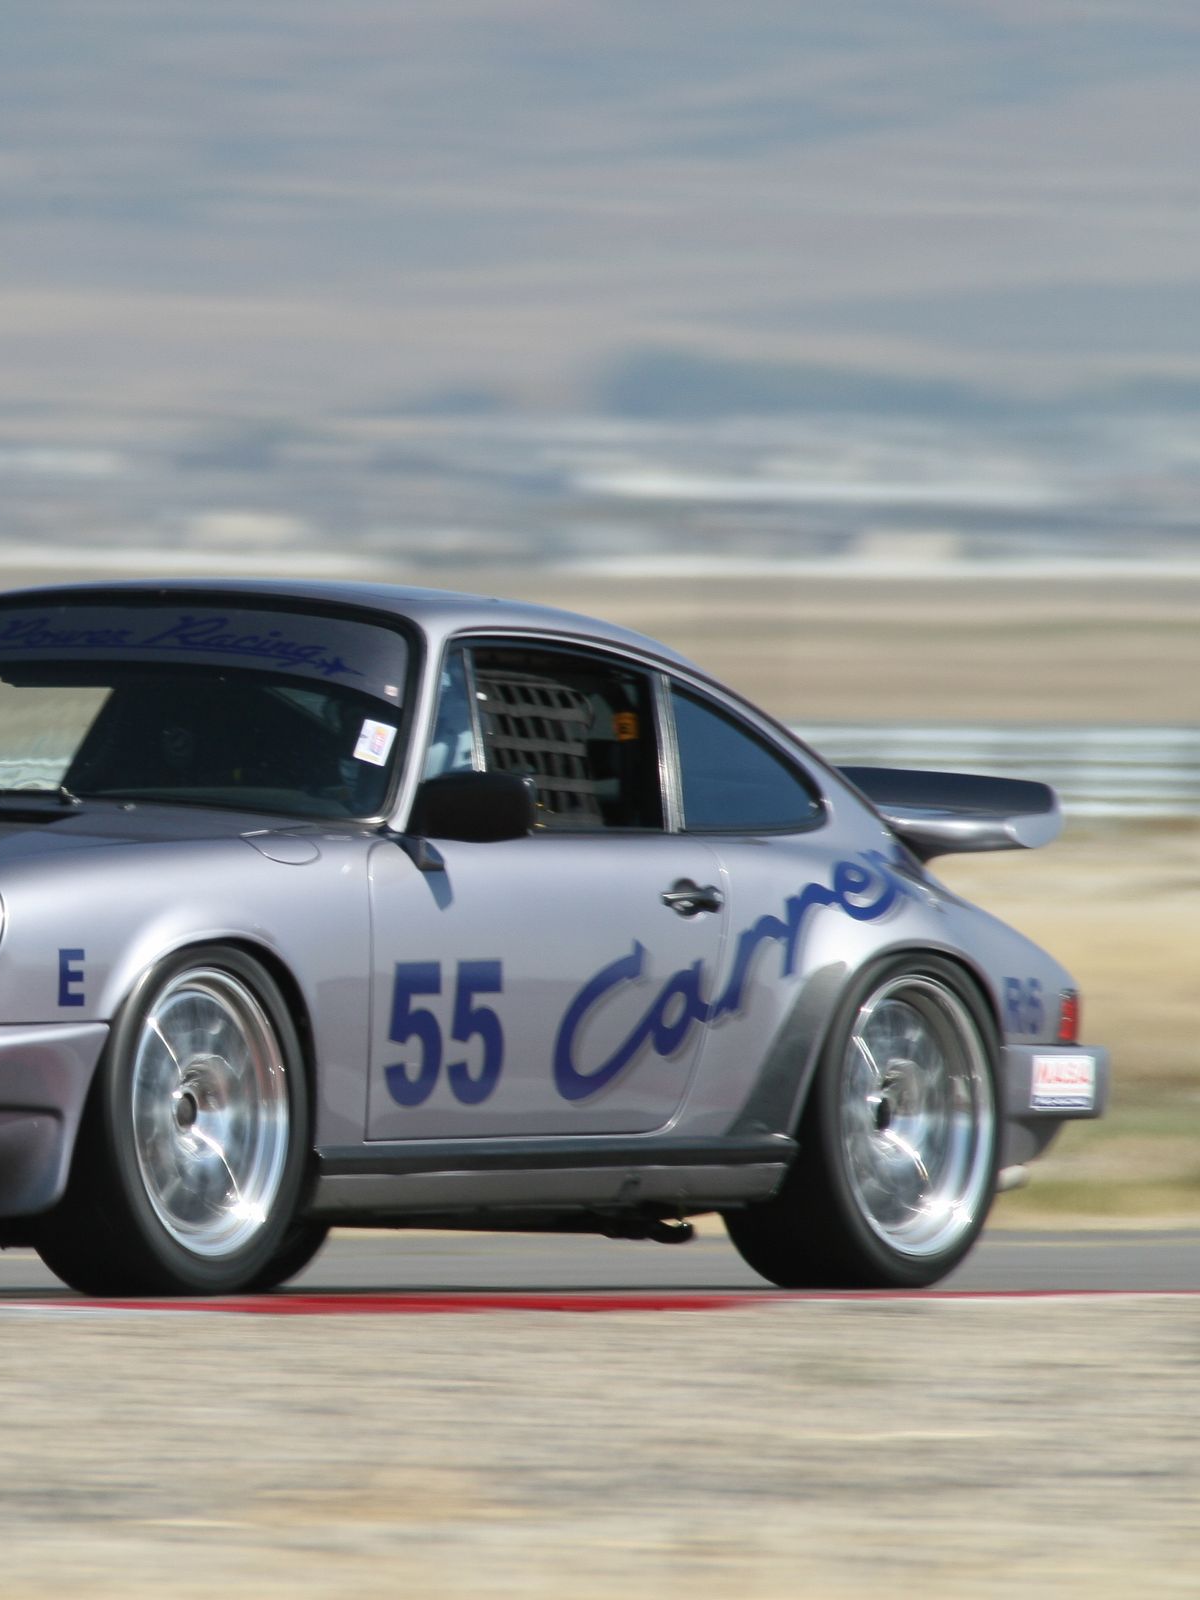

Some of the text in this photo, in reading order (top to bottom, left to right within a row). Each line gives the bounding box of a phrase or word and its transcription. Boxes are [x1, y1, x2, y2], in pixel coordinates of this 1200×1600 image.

[144, 614, 327, 667] Racing
[58, 948, 85, 1006] E
[384, 960, 504, 1108] 55
